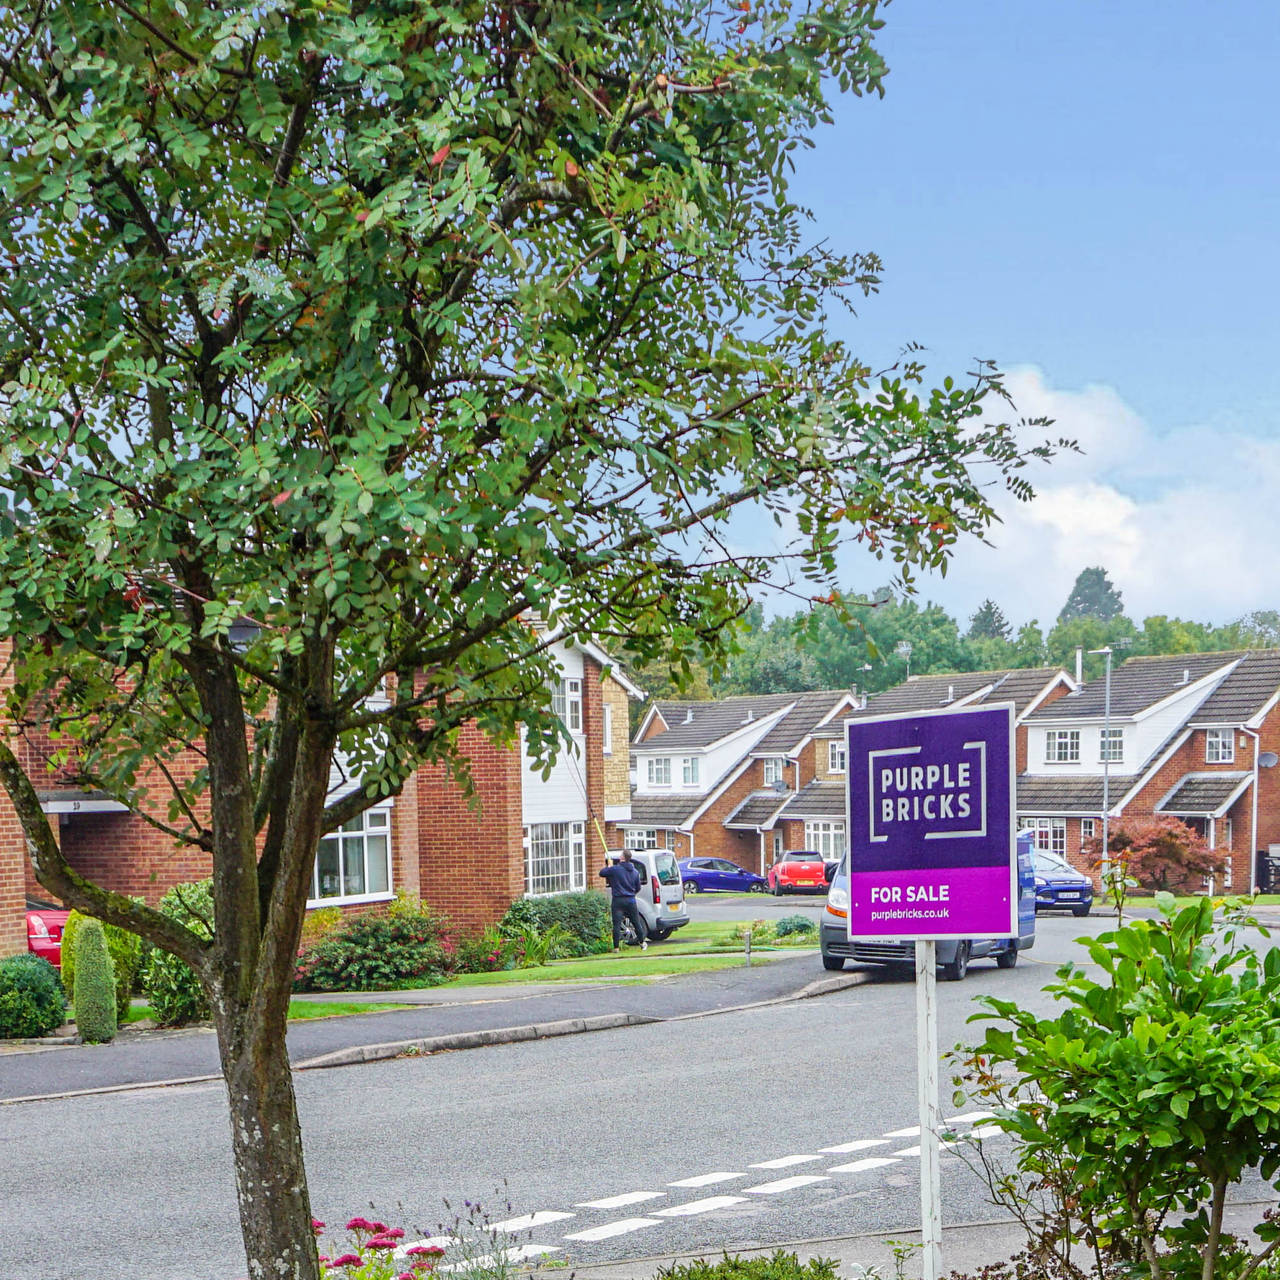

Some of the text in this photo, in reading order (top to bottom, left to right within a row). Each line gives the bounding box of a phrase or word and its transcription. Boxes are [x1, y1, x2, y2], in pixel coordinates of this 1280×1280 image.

[881, 762, 970, 793] PURPLE
[882, 793, 971, 822] BRICKS
[871, 885, 950, 903] FOR SALE
[871, 908, 950, 921] purplebricks.co.uk
